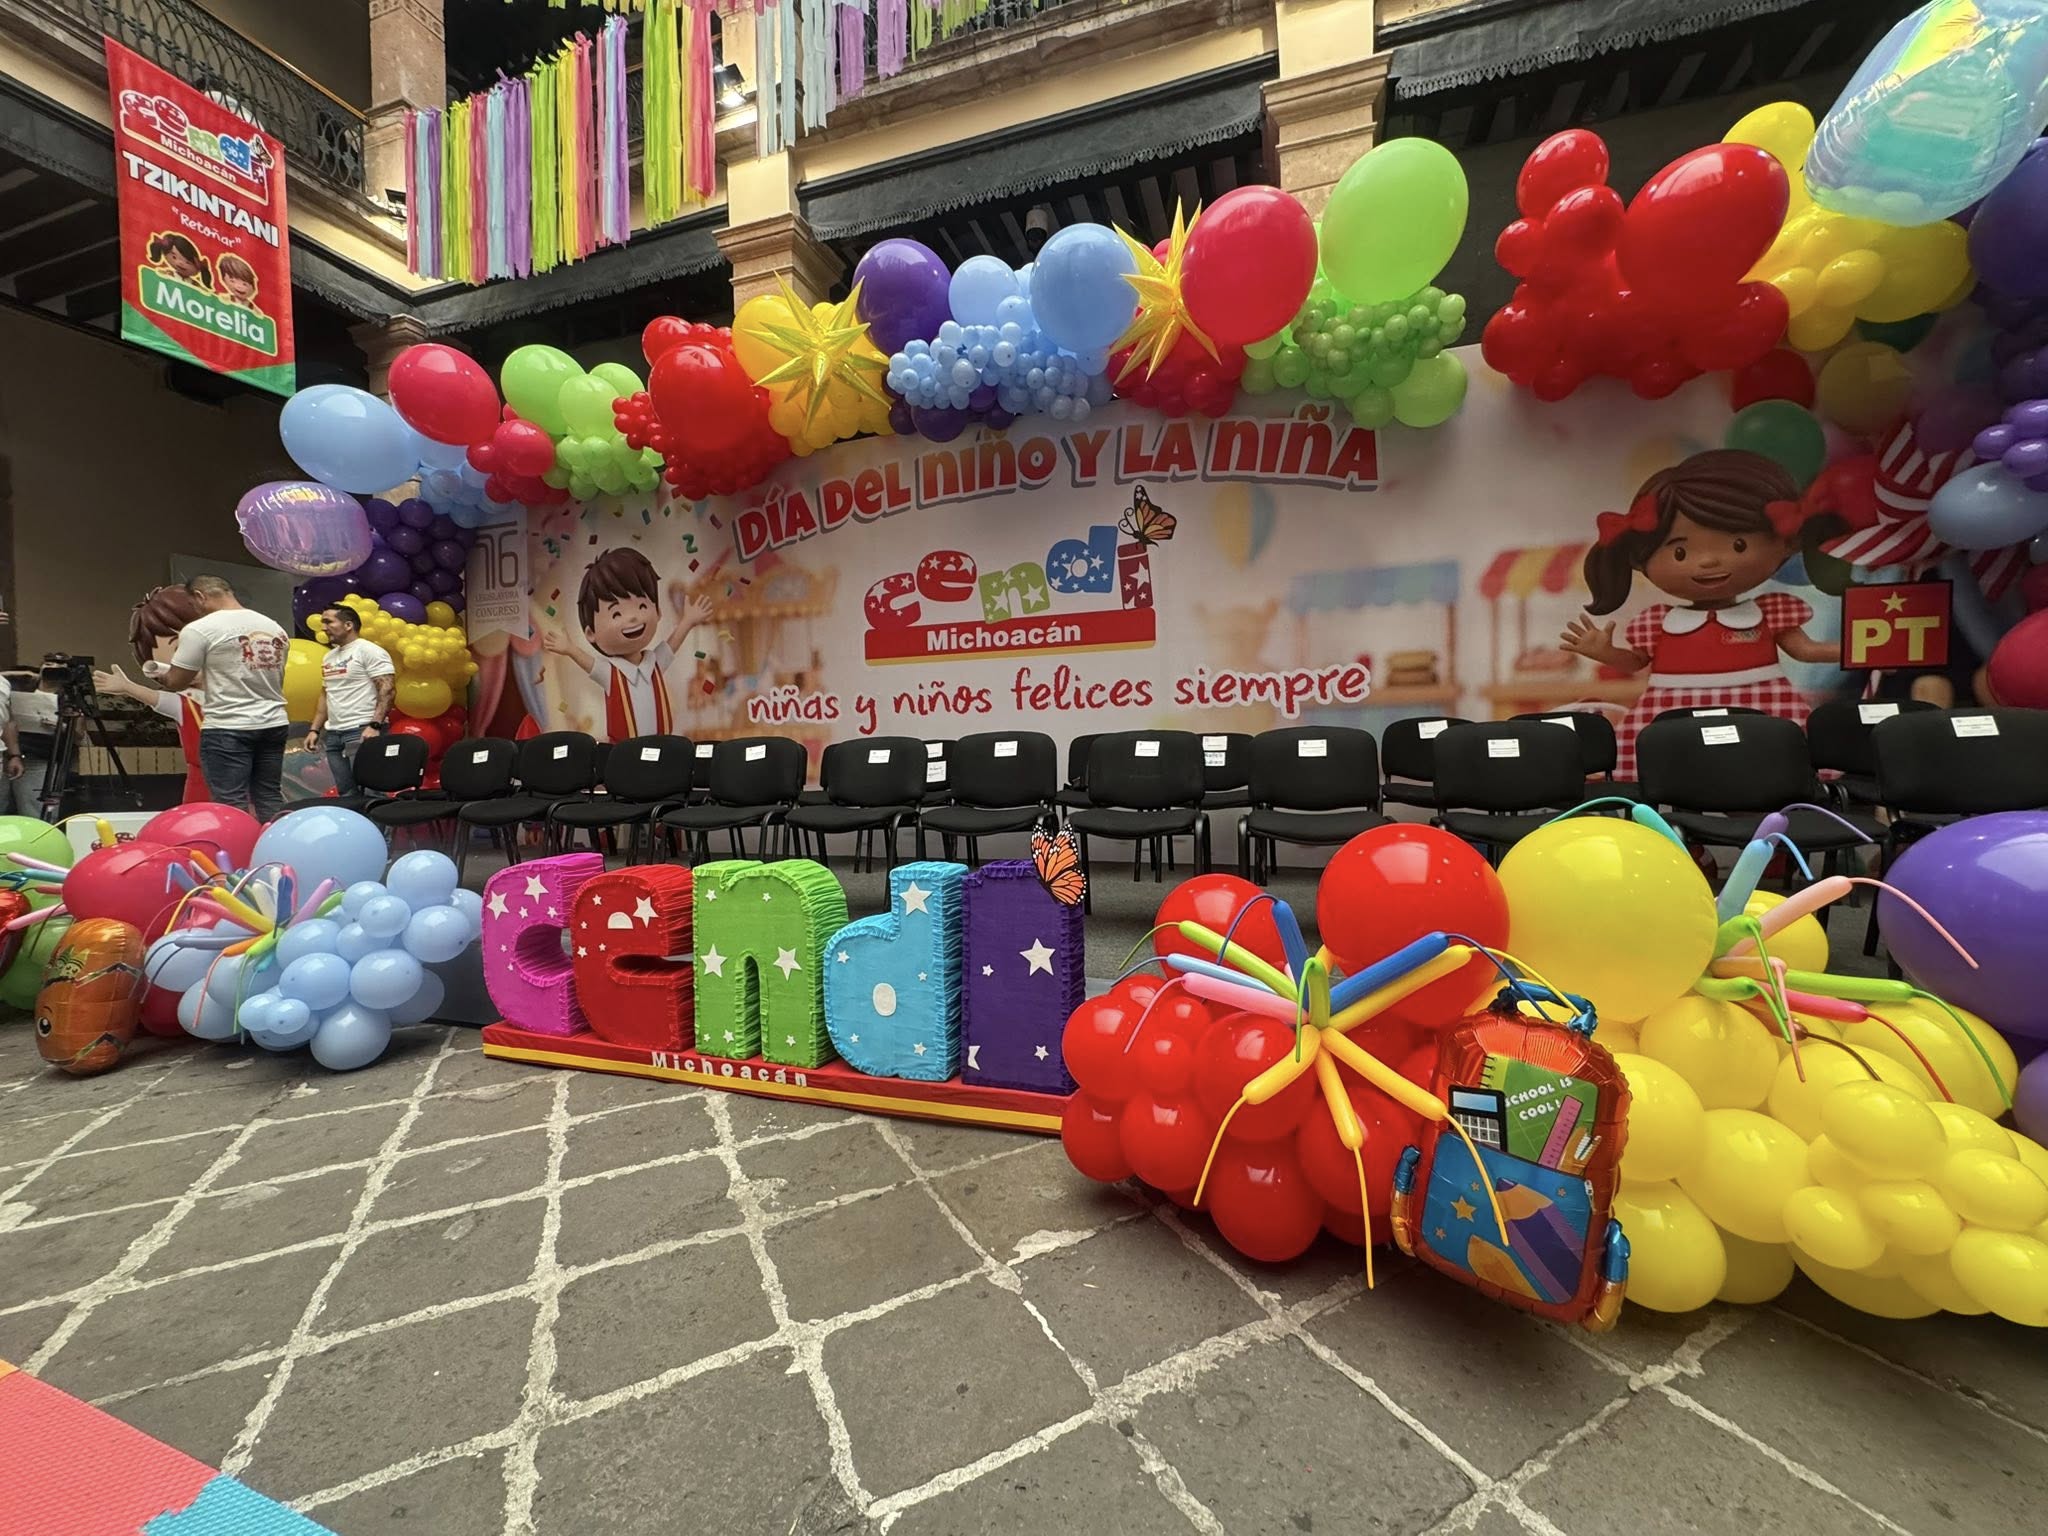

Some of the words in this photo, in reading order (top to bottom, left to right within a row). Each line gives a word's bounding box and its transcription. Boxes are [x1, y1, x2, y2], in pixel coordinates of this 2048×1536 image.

[160, 134, 237, 183] Michoacán
[122, 151, 279, 247] TZIKINTANI
[156, 281, 265, 344] Morelia
[737, 486, 817, 556] DÍA
[1070, 430, 1111, 478] Y
[1122, 422, 1197, 474] LA
[864, 525, 1154, 628] cendi
[475, 605, 520, 618] CONGRESO
[926, 621, 1081, 652] Michoacán
[1851, 616, 1940, 663] PT
[750, 688, 839, 721] niñas
[855, 693, 877, 735] y
[893, 681, 993, 716] niños
[1010, 664, 1153, 711] felices
[1174, 667, 1366, 714] siempre
[651, 1051, 807, 1088] Michoacán
[1505, 1083, 1555, 1108] SCHOOL
[1560, 1076, 1573, 1089] IS
